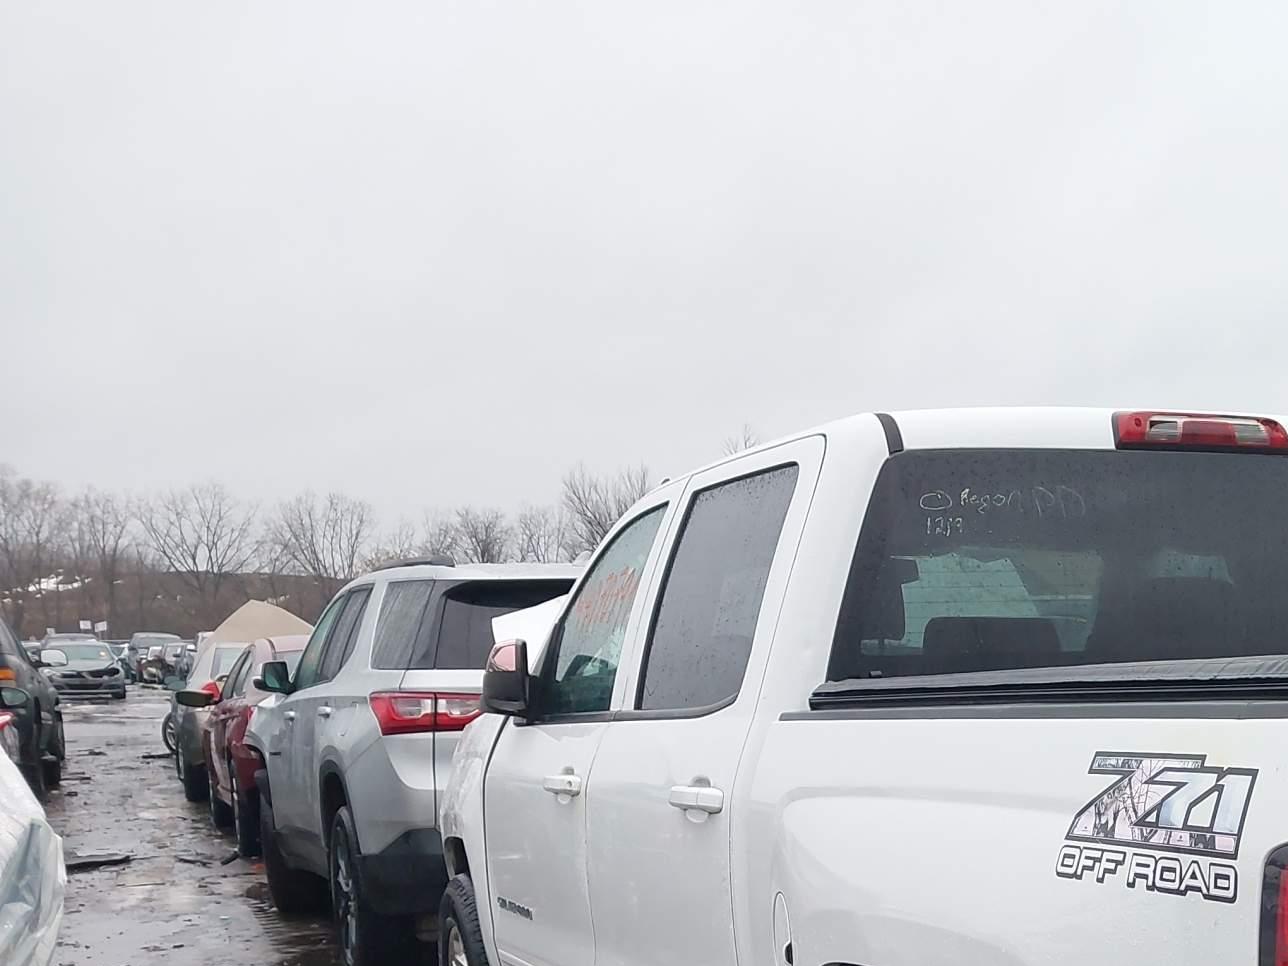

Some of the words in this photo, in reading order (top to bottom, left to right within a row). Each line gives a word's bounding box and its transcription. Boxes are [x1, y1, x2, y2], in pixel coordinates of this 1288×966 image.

[1064, 751, 1259, 859] Z71
[1055, 845, 1126, 883] OFF
[1127, 853, 1238, 904] ROAD
